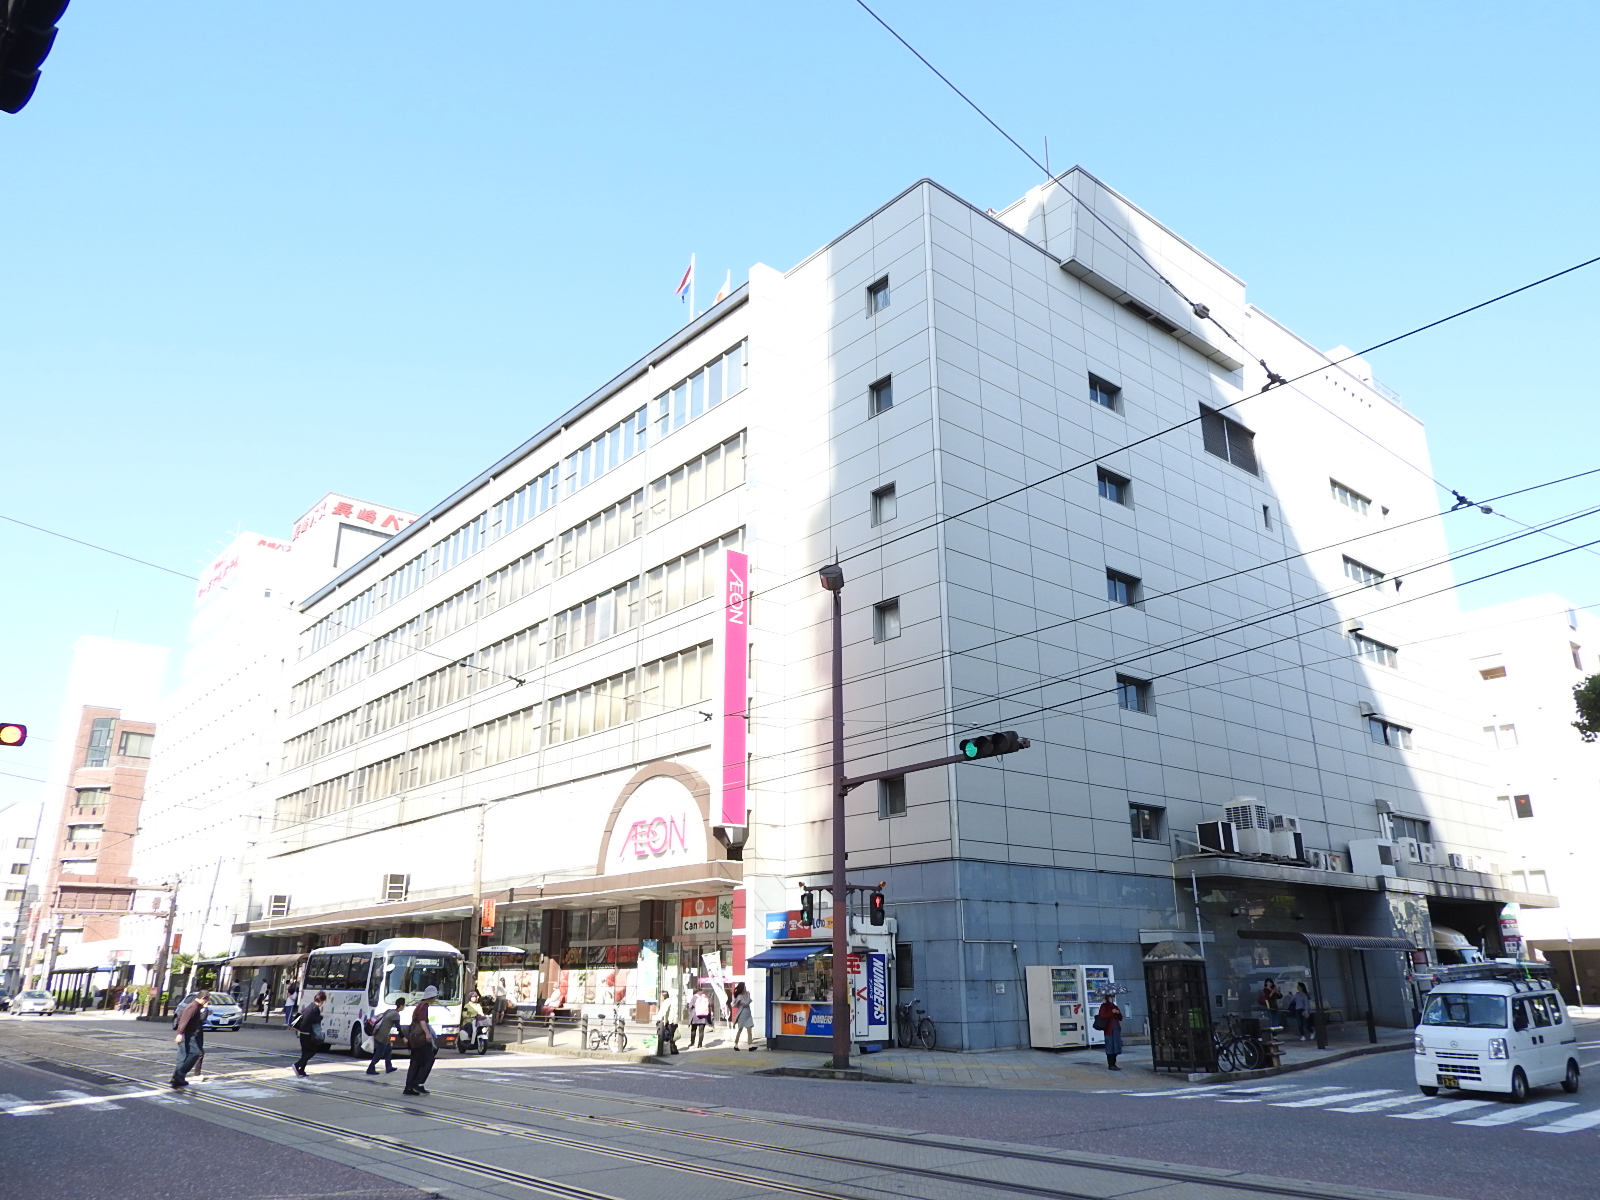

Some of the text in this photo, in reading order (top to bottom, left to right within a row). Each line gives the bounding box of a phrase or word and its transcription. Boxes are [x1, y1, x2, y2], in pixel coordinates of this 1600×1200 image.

[332, 501, 415, 531] 長崎バ
[873, 957, 885, 1022] NUMBERS
[784, 1012, 798, 1024] LOTO
